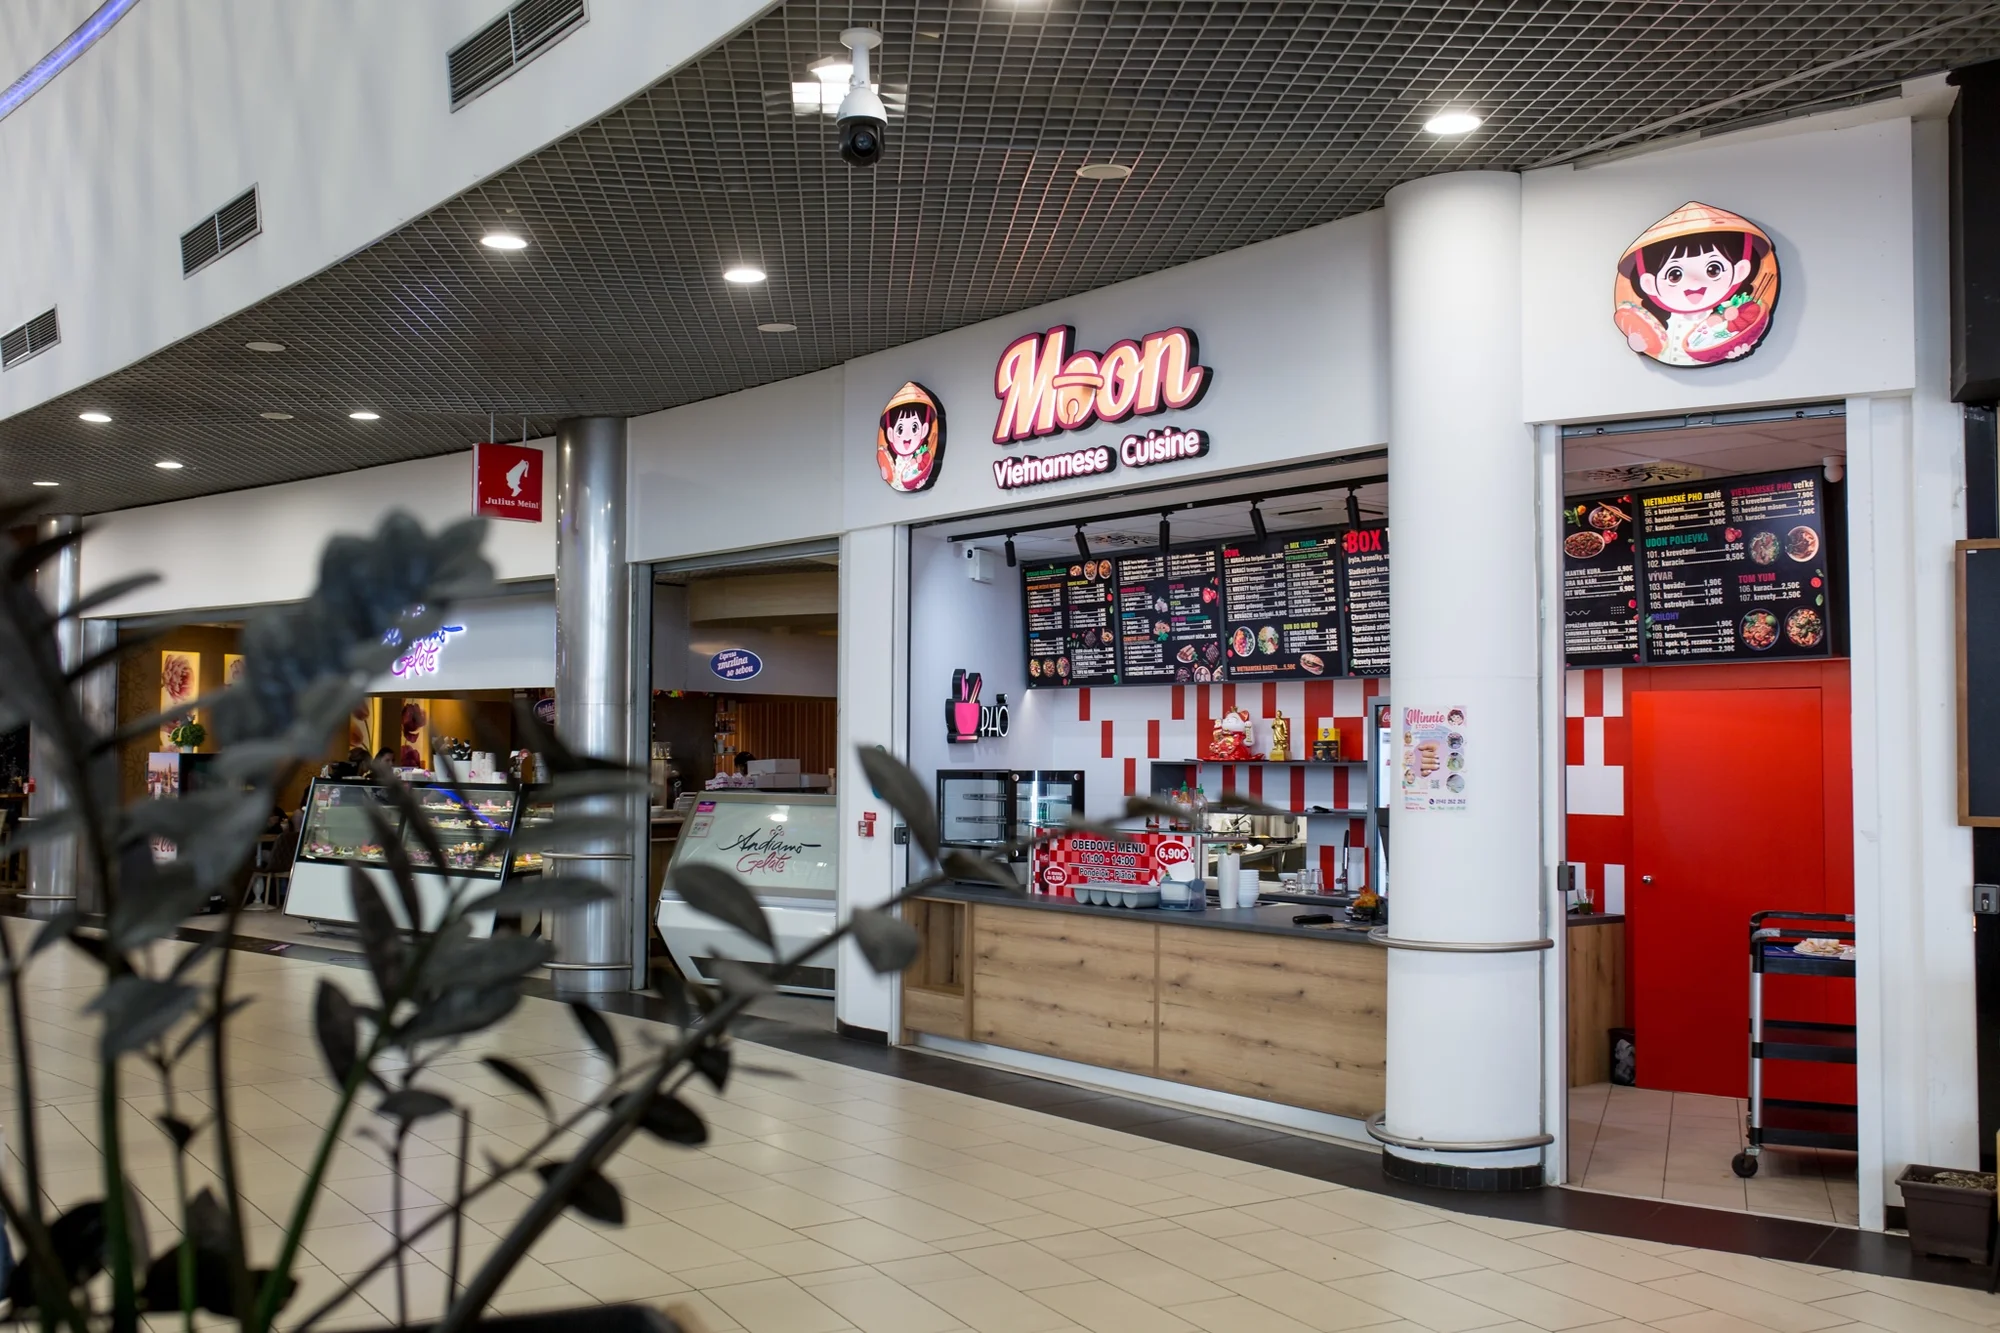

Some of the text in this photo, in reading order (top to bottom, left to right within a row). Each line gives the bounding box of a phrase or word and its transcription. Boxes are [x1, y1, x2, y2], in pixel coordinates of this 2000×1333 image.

[993, 324, 1208, 444] Moon
[993, 427, 1206, 489] Vietnamese Cuisine
[1776, 482, 1792, 491] PHO
[485, 497, 538, 509] Julius Meinl
[1643, 490, 1721, 506] VIETNAMSKÉ PHO malé
[1347, 529, 1382, 554] BOX
[1646, 533, 1708, 548] UDON POLIEVKA
[1666, 547, 1696, 556] krevetami
[1724, 543, 1744, 552] 8,50€
[1662, 558, 1684, 567] kuracie
[1726, 552, 1744, 561] 8,50€
[1704, 578, 1722, 586] 1,90€
[1738, 572, 1776, 584] TOM YUM
[1781, 582, 1800, 590] 2,50€
[1650, 592, 1662, 600] 104.
[1704, 588, 1722, 596] 1,90€
[1782, 591, 1801, 599] 2,50€
[1705, 598, 1723, 606] 1,90€
[391, 642, 439, 679] Gelato
[718, 656, 748, 670] zmrzlina
[735, 666, 754, 676] sebou
[1406, 708, 1445, 726] Minnie
[716, 827, 821, 854] Andiamo
[1118, 842, 1146, 854] MENU
[1159, 848, 1187, 860] 6,90€
[736, 851, 792, 875] Gelato
[1082, 854, 1104, 864] 11:00
[1112, 855, 1135, 866] 14:00
[1080, 866, 1110, 878] Pondelok
[1114, 870, 1136, 880] Piatok
